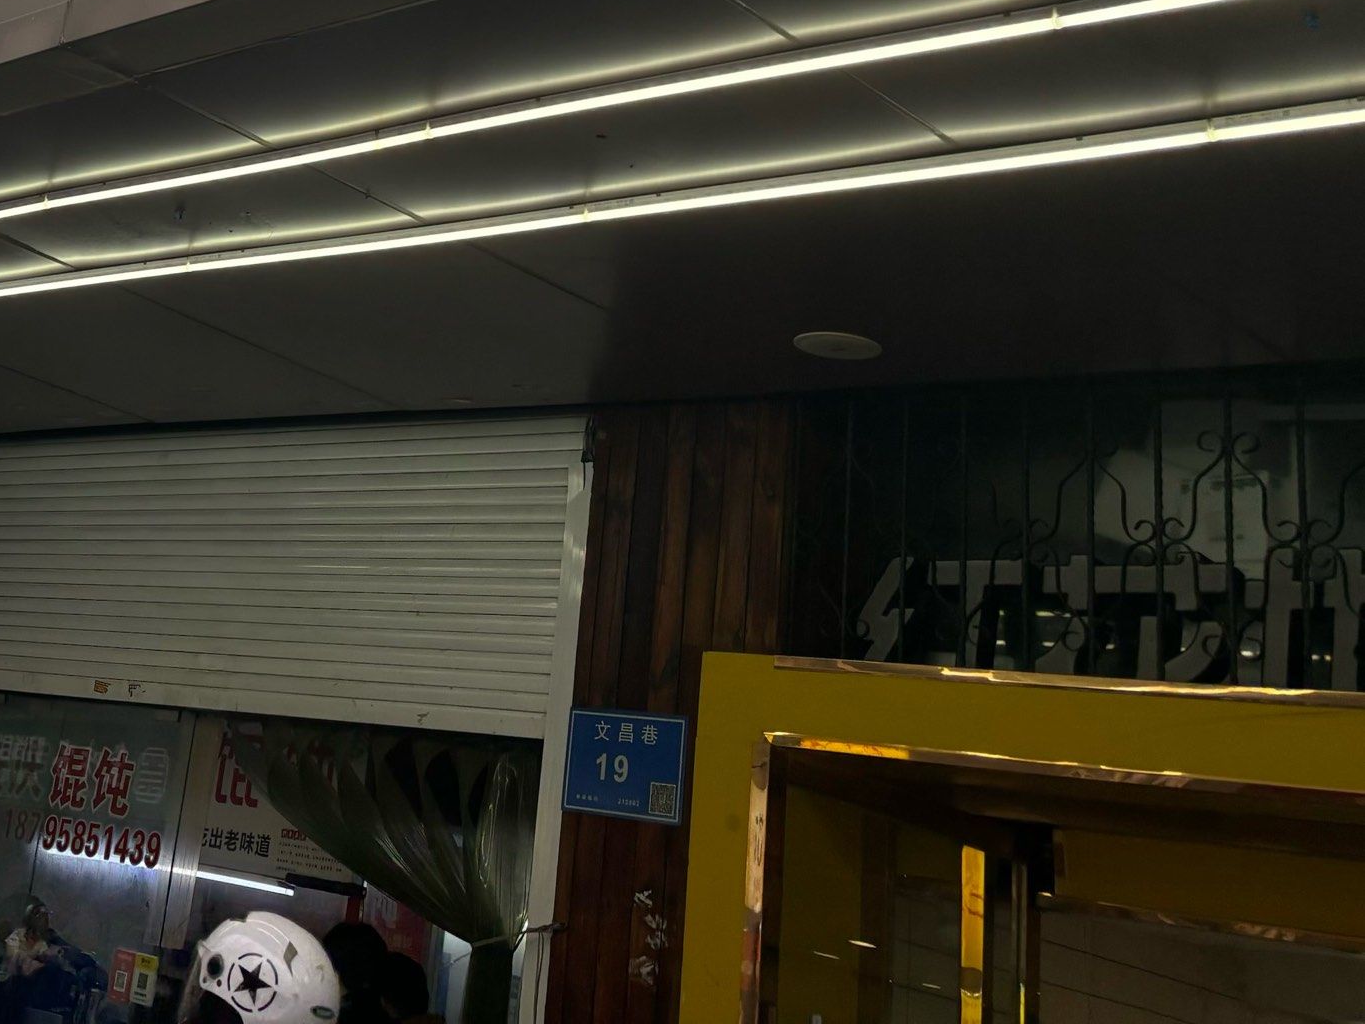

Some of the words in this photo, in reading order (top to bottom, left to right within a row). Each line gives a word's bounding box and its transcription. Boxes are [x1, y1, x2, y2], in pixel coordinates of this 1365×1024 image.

[594, 720, 658, 746] 文昌巷
[596, 752, 629, 784] 19
[5, 808, 161, 868] 18795851439
